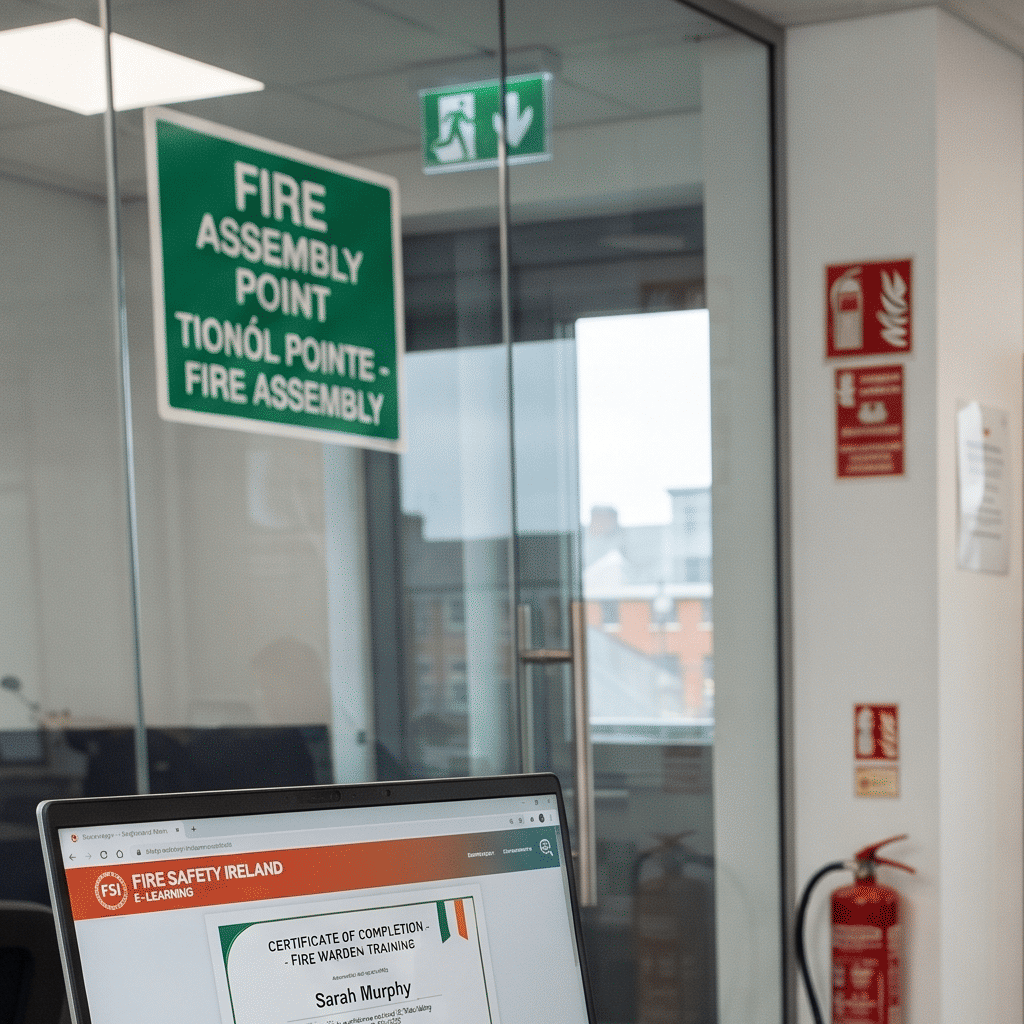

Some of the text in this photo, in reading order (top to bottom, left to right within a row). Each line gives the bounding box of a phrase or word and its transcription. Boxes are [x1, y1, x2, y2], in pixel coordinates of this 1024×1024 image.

[233, 160, 328, 233] FIRE
[196, 212, 364, 285] ASSEMBLY
[235, 266, 331, 322] POINT
[174, 311, 281, 364] TIONÓL
[184, 360, 385, 425] FIRE ASSEMBLY
[101, 883, 121, 897] FSI
[131, 860, 284, 890] FIRE SAFETY IRELAND
[134, 887, 194, 903] E-LEARNING
[268, 932, 340, 952] CERTIFICATE
[342, 930, 355, 942] OF
[358, 921, 424, 940] COMPLETION
[291, 953, 316, 966] FIRE
[318, 946, 365, 962] WARDEN
[315, 981, 412, 1008] Sarah Murphy
